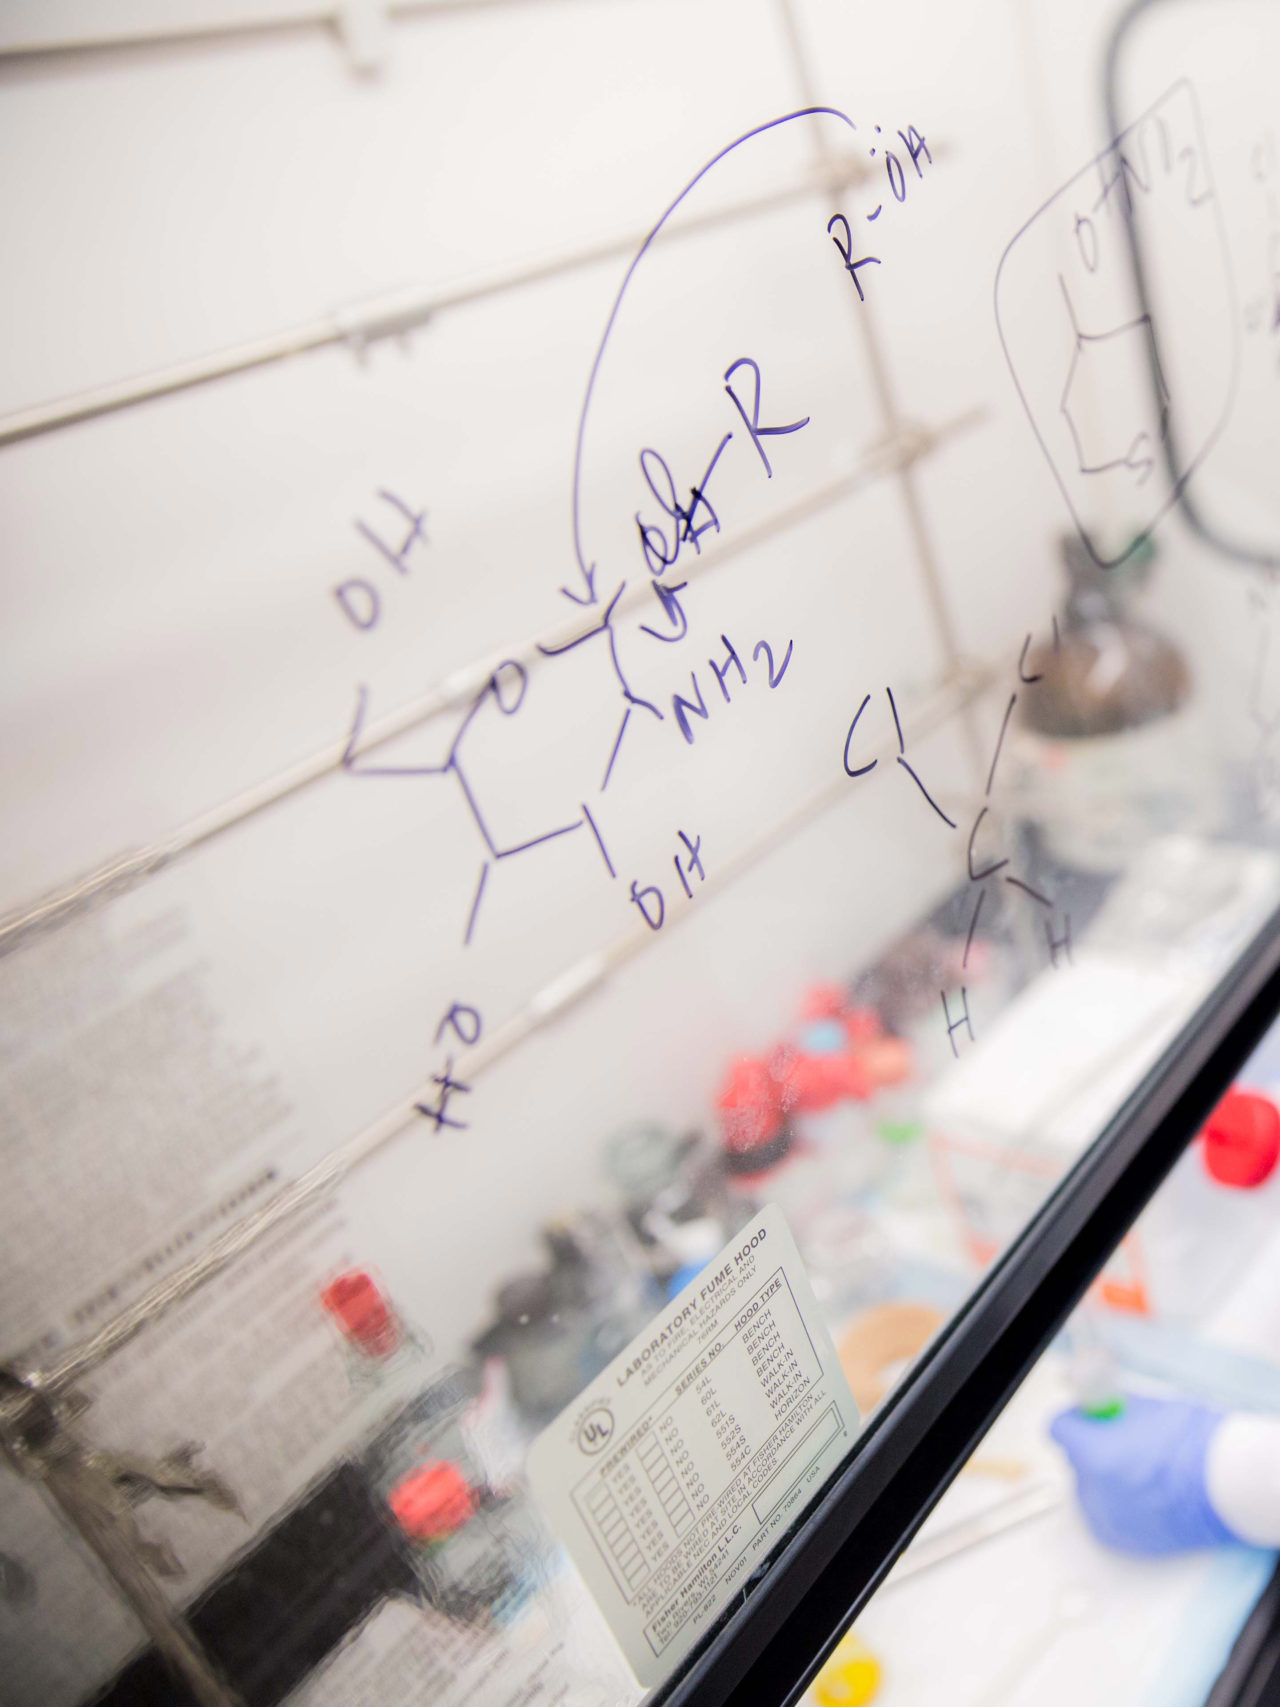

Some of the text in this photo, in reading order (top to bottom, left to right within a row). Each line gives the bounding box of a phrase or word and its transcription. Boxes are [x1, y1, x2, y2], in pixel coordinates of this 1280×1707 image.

[616, 1225, 767, 1389] LABORATORY FUME HOOD
[643, 1263, 757, 1388] MECHANICAL HAZARDS ONLY
[675, 1356, 707, 1395] SERIES
[733, 1300, 759, 1331] HOOD
[759, 1277, 780, 1304] TYPE
[689, 1272, 737, 1326] ELECTRICAL
[737, 1253, 755, 1275] AND
[583, 1417, 610, 1443] UL
[658, 1413, 673, 1434] NO
[741, 1307, 771, 1344] BENCH
[663, 1425, 679, 1445] NO
[746, 1319, 776, 1355] BENCH
[669, 1436, 684, 1457] NO
[751, 1330, 780, 1367] BENCH
[674, 1448, 689, 1468] NO
[755, 1341, 785, 1378] BENCH
[679, 1459, 695, 1479] NO
[760, 1347, 793, 1389] WALK-IN
[685, 1470, 700, 1490] NO
[764, 1358, 798, 1399] WALK-IN
[683, 1526, 700, 1548] NOT
[741, 1465, 751, 1479] AT
[752, 1433, 778, 1467] FISHER
[778, 1392, 813, 1435] HAMILTON
[683, 1527, 709, 1560] WIRED
[709, 1514, 719, 1529] AT
[720, 1493, 737, 1516] SITE
[737, 1482, 746, 1496] IN
[745, 1424, 795, 1485] ACCORDANCE
[795, 1402, 813, 1427] WITH
[813, 1387, 826, 1405] ALL
[690, 1481, 705, 1501] NO
[769, 1369, 802, 1410] WALK-IN
[695, 1492, 710, 1512] NO
[774, 1375, 810, 1421] HORIZON
[710, 1516, 727, 1539] AND
[727, 1487, 752, 1519] LOCAL
[751, 1526, 770, 1551] PART
[805, 1463, 820, 1484] USA
[651, 1520, 741, 1632] Fisher Hamilton L.L.C.
